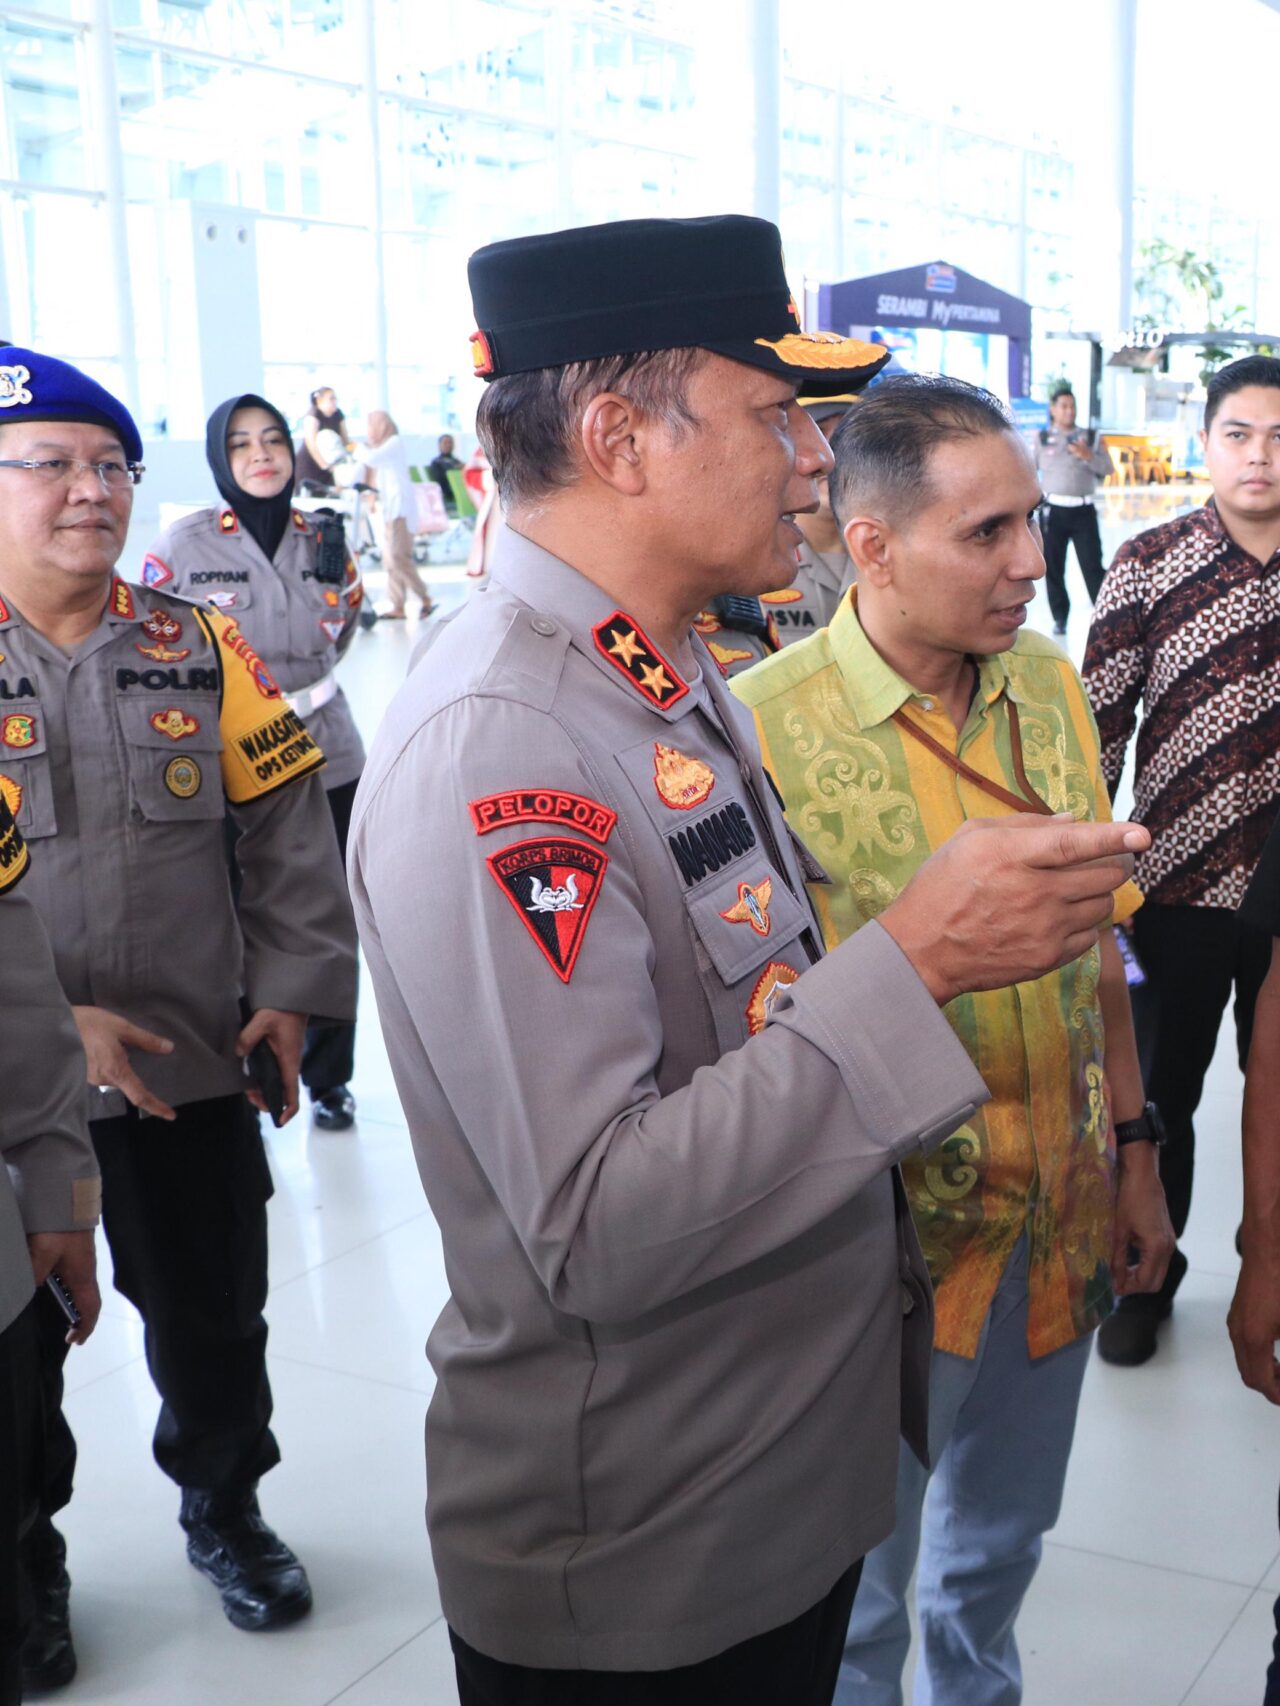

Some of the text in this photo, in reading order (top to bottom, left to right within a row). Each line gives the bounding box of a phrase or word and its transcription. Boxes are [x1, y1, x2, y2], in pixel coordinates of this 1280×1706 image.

[189, 571, 249, 585] ROPIYANI
[116, 668, 218, 691] POLRI
[255, 755, 283, 781] OPS
[478, 795, 608, 833] PELOPOR
[668, 801, 756, 887] NANANG
[501, 847, 597, 873] KORPS BRIMOB
